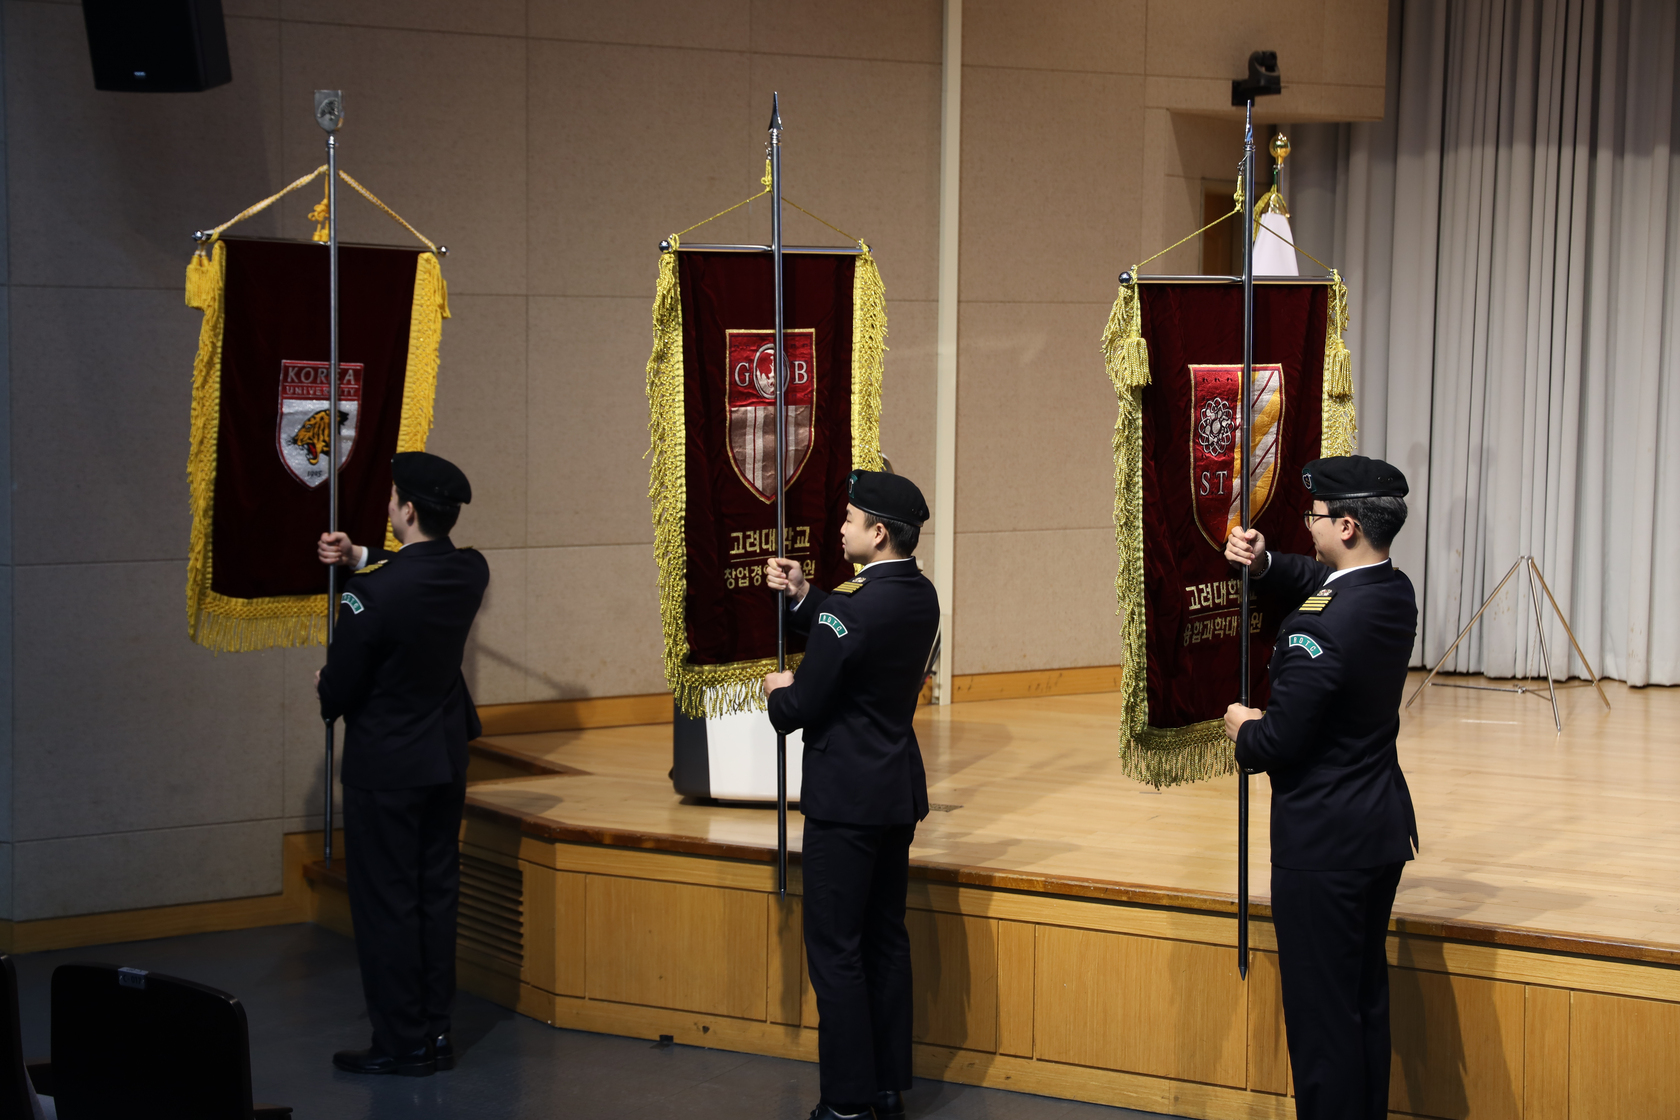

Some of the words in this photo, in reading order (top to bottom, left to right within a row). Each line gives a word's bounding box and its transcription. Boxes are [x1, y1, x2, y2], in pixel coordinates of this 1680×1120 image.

[286, 386, 356, 396] UNIVERITY
[724, 560, 816, 589] 창업경원
[1183, 612, 1263, 647] 융합과학대원
